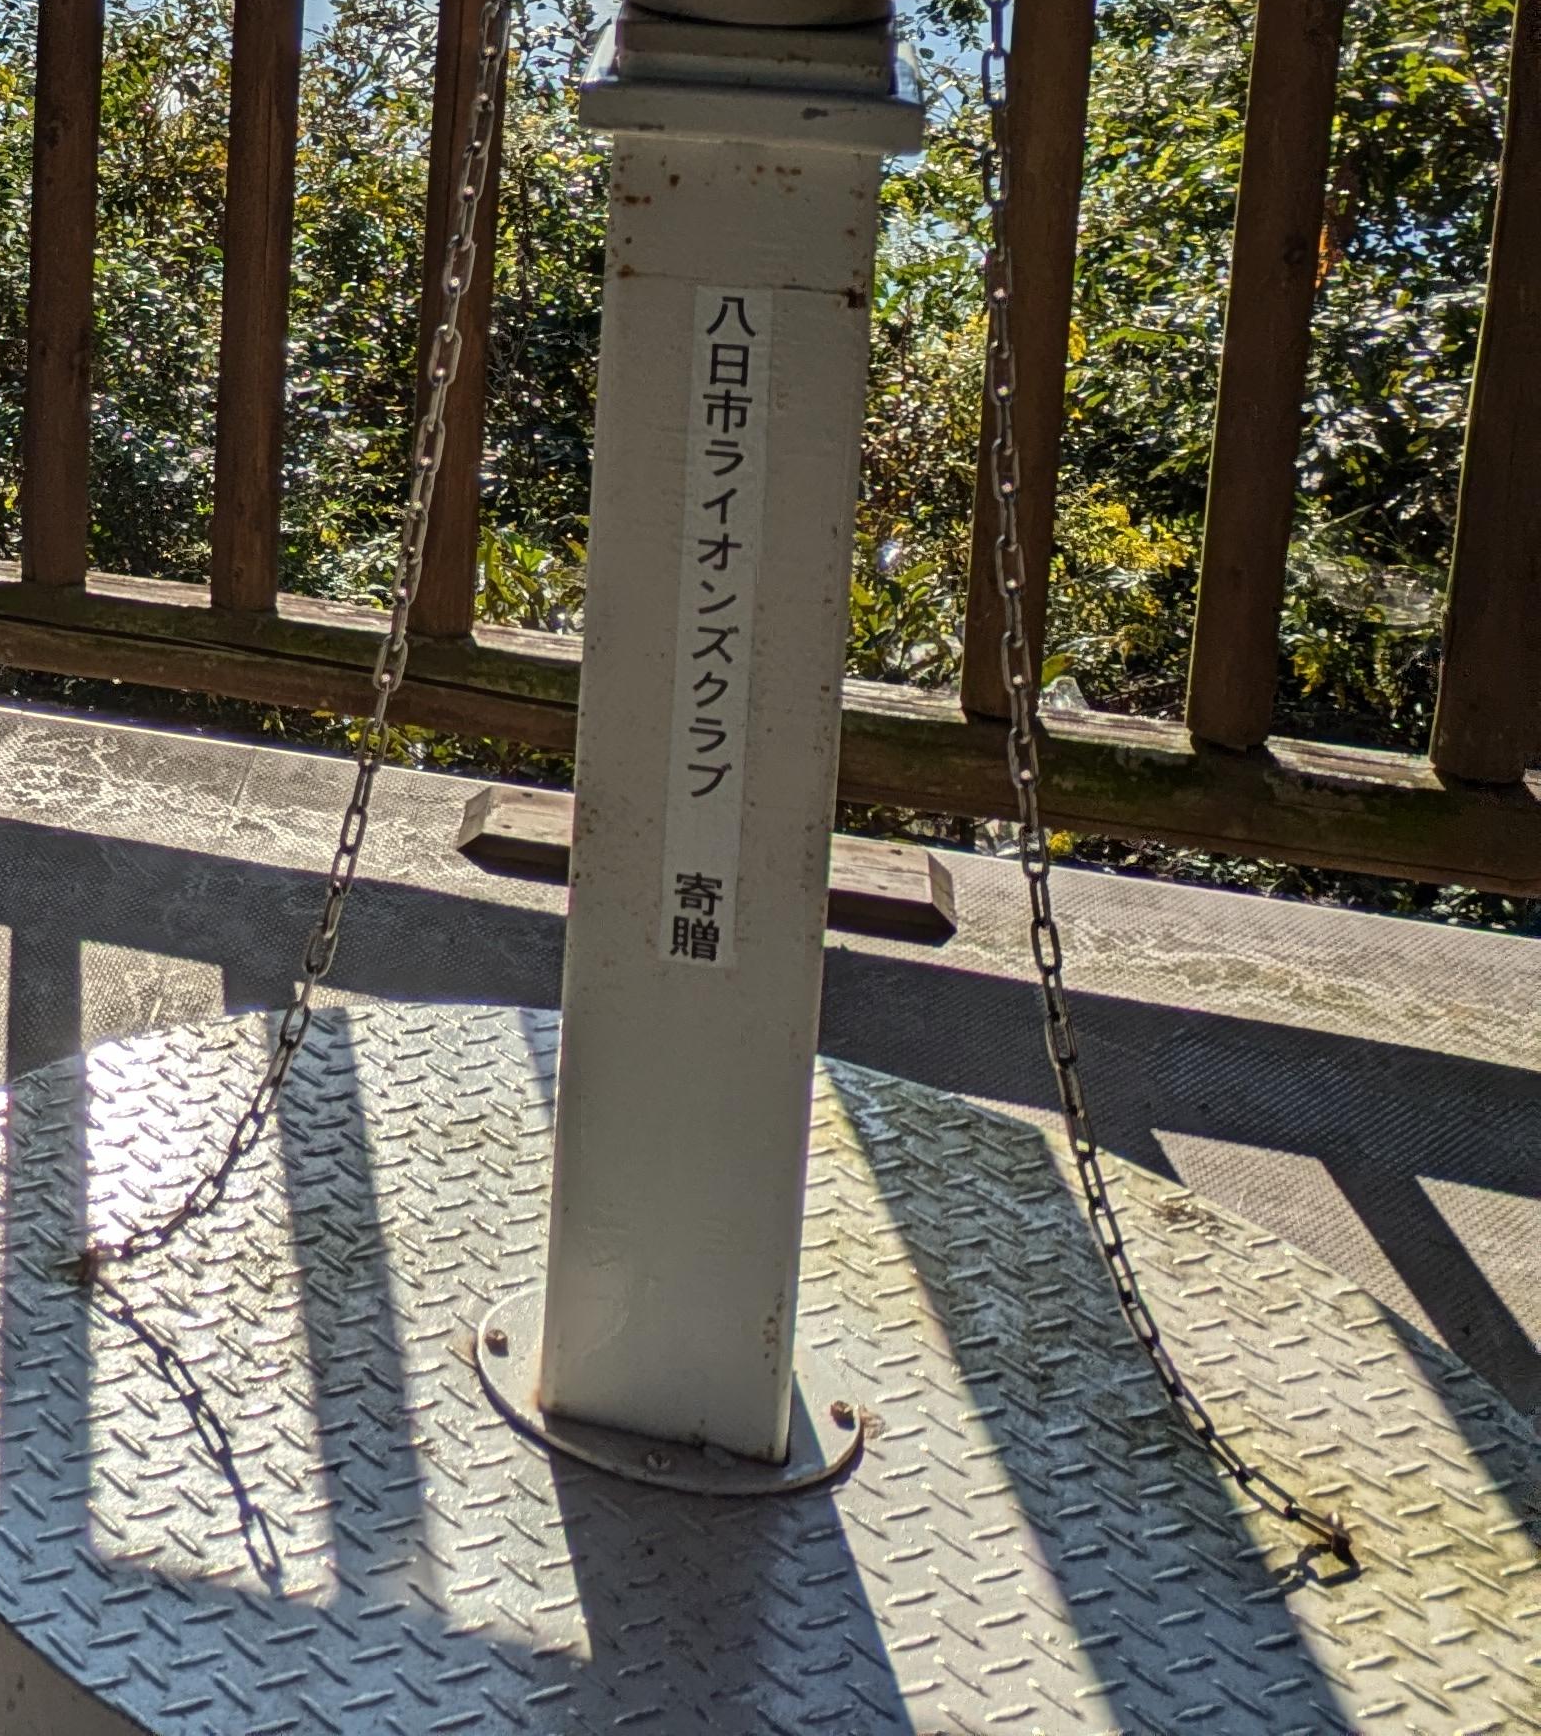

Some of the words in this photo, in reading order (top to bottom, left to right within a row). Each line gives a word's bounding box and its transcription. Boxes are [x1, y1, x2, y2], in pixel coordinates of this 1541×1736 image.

[687, 293, 757, 799] 八日市ライオンズクラブ
[669, 871, 724, 962] 寄贈
